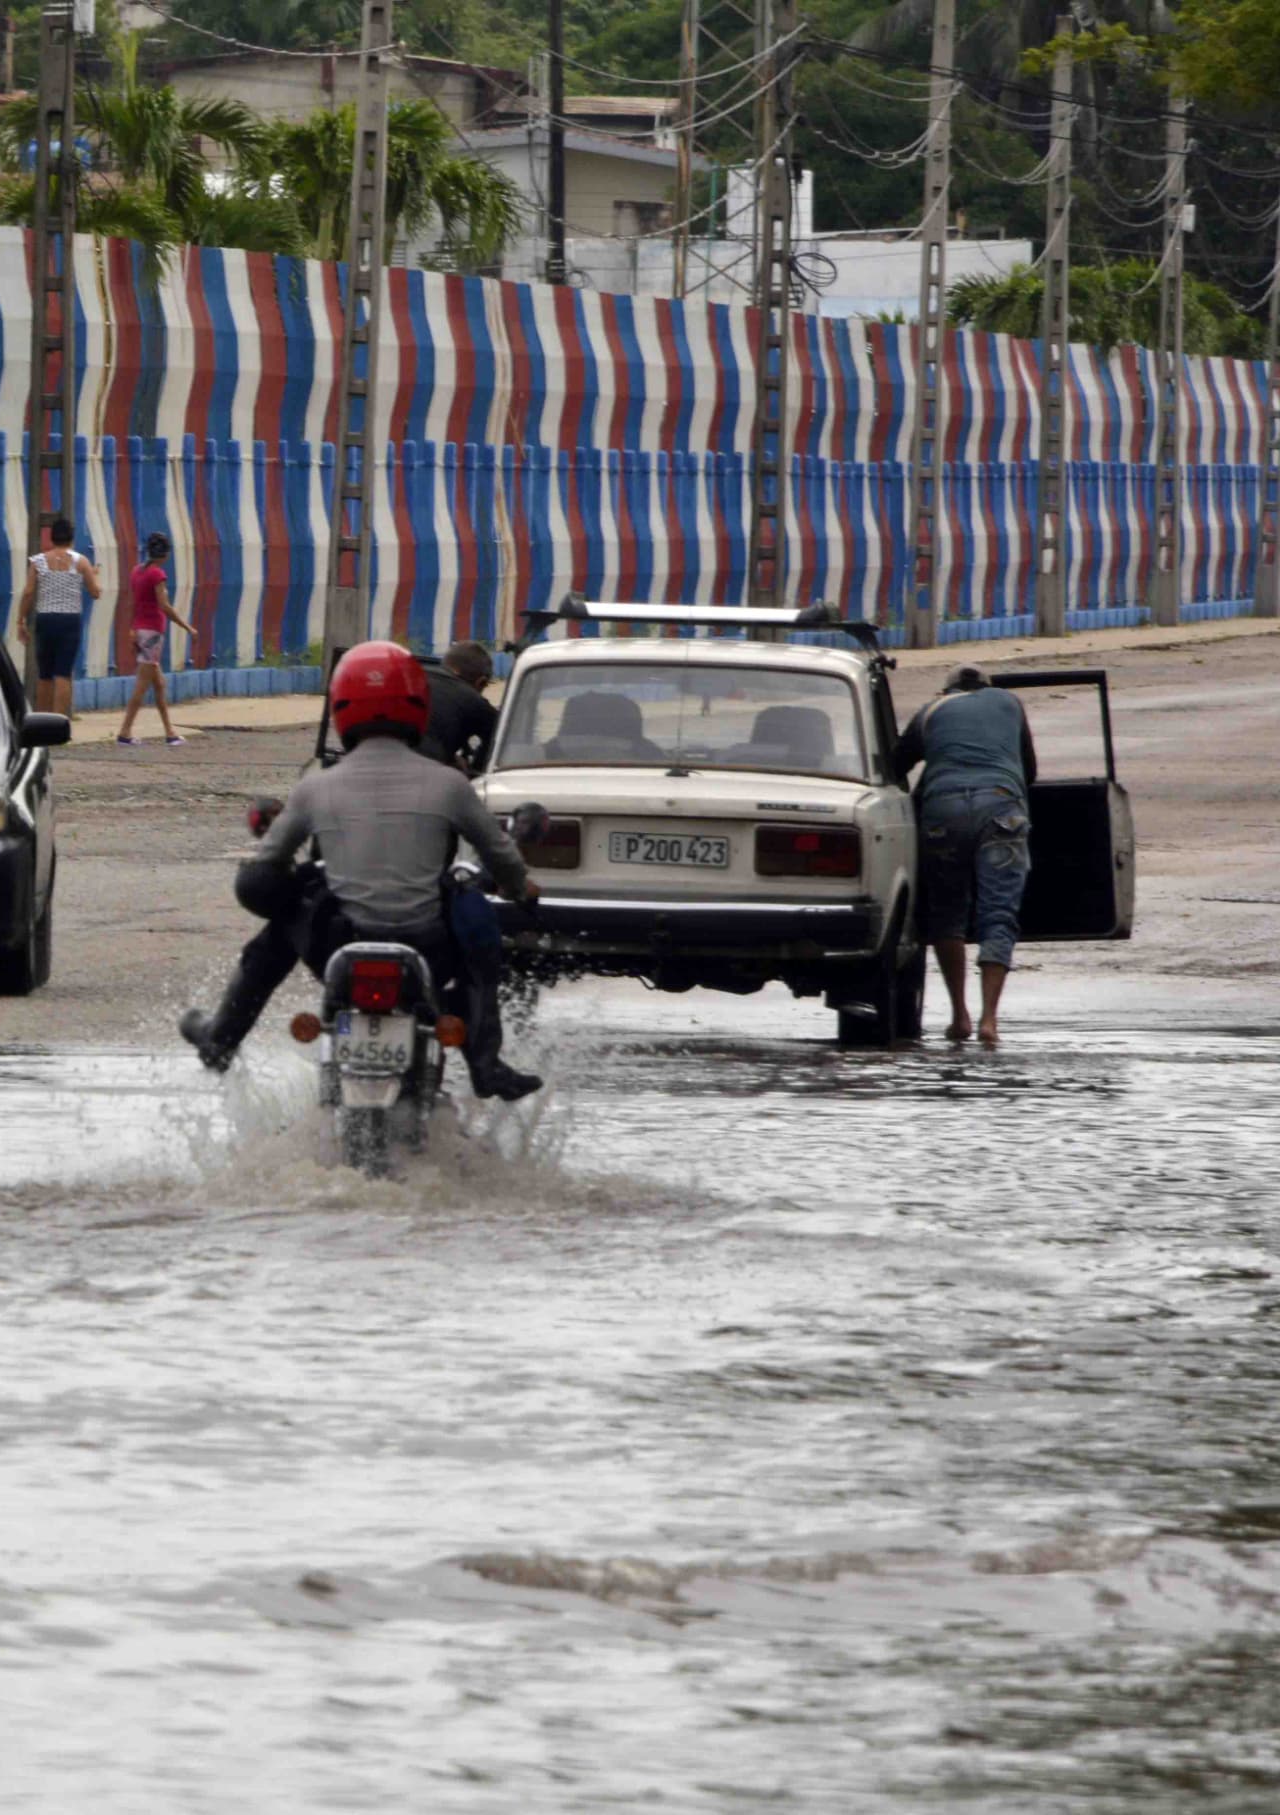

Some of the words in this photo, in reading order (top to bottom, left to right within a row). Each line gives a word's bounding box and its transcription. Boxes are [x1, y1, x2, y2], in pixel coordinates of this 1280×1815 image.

[626, 837, 640, 860] P
[643, 838, 683, 863] 200
[686, 841, 726, 865] 423
